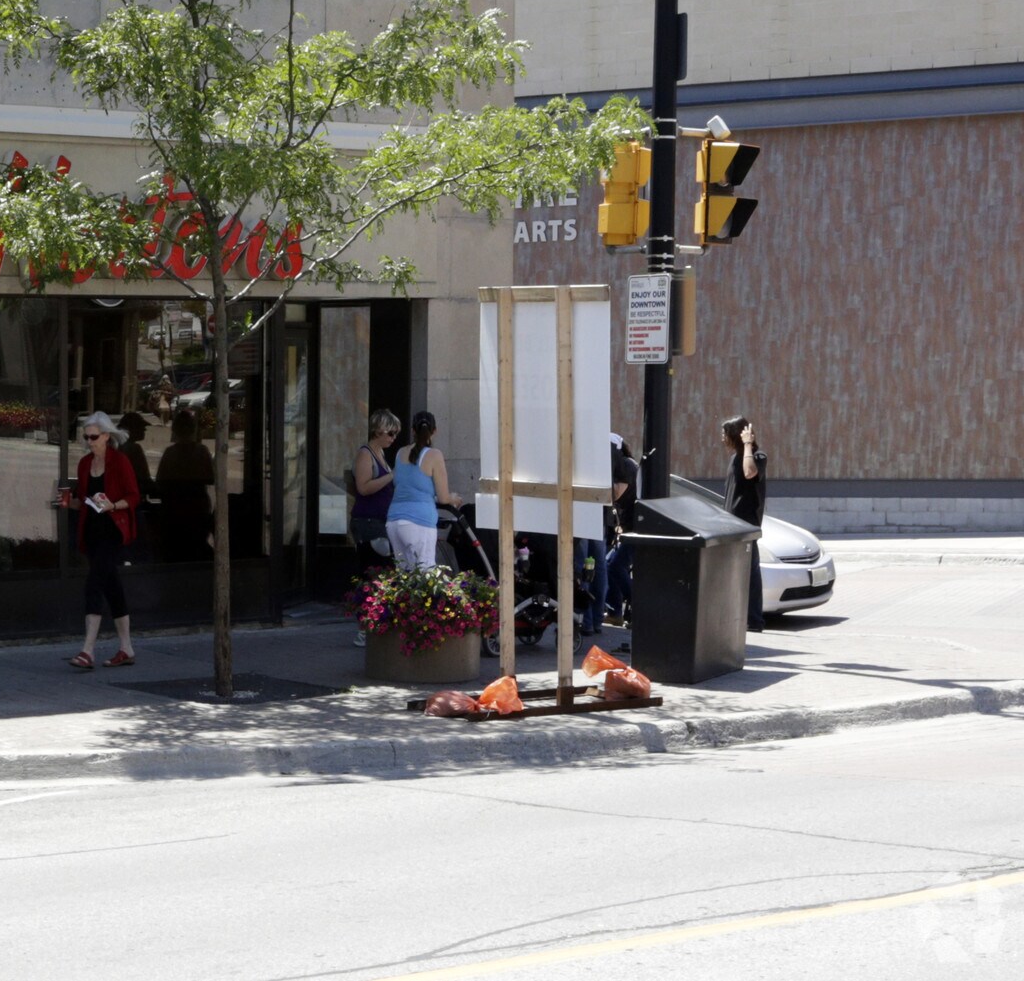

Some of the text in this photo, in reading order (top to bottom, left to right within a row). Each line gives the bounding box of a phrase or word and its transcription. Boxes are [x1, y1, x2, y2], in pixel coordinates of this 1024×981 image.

[514, 219, 577, 243] ARTS
[631, 290, 666, 299] ENJOY OUR
